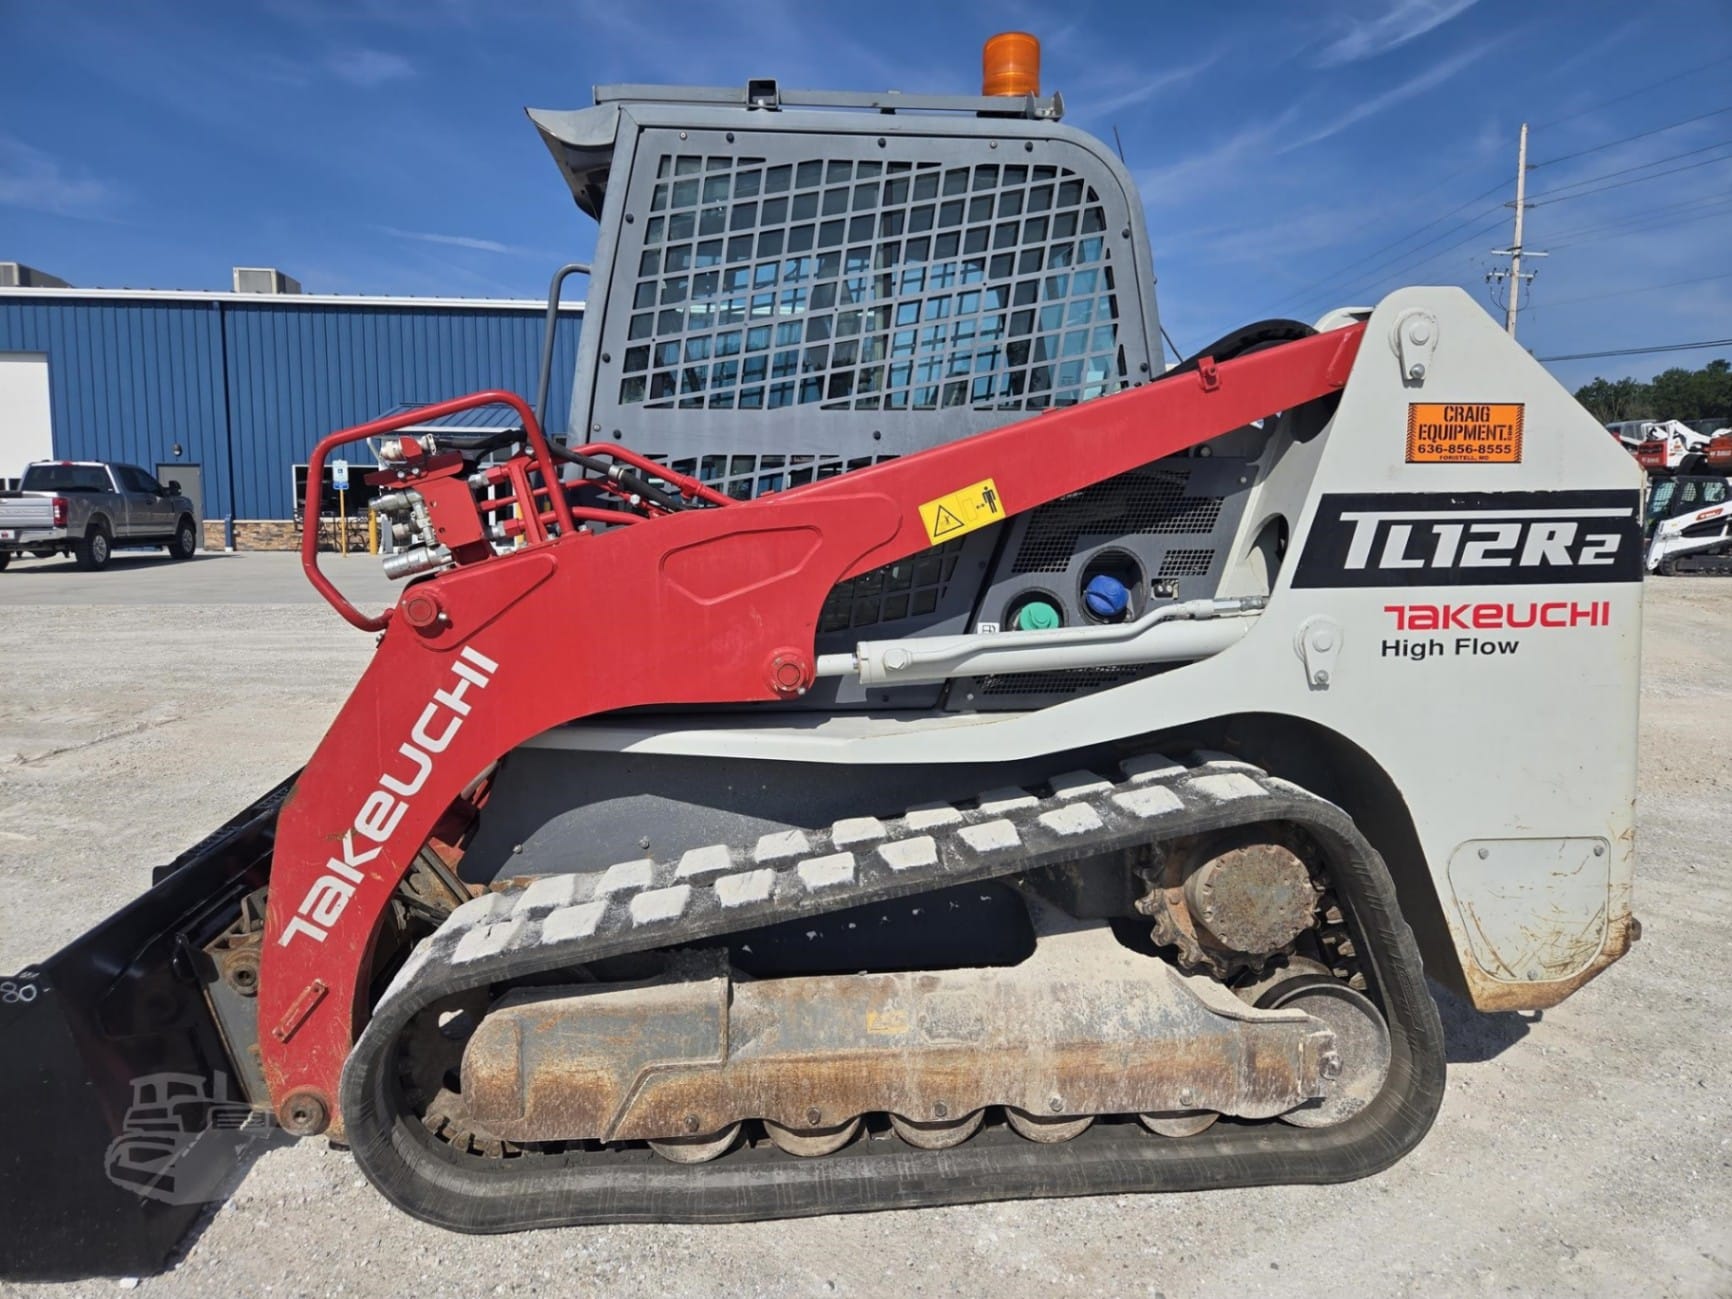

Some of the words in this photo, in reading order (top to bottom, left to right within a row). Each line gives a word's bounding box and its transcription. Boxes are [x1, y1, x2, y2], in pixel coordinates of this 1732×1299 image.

[1443, 405, 1491, 423] CRAIG
[1417, 444, 1512, 455] 636-856-8555
[1339, 507, 1634, 570] TL12R2
[1384, 601, 1611, 631] TAKEUCHI
[1381, 639, 1444, 661] High
[1455, 638, 1520, 656] Flow
[278, 645, 499, 948] TAKEUCHI
